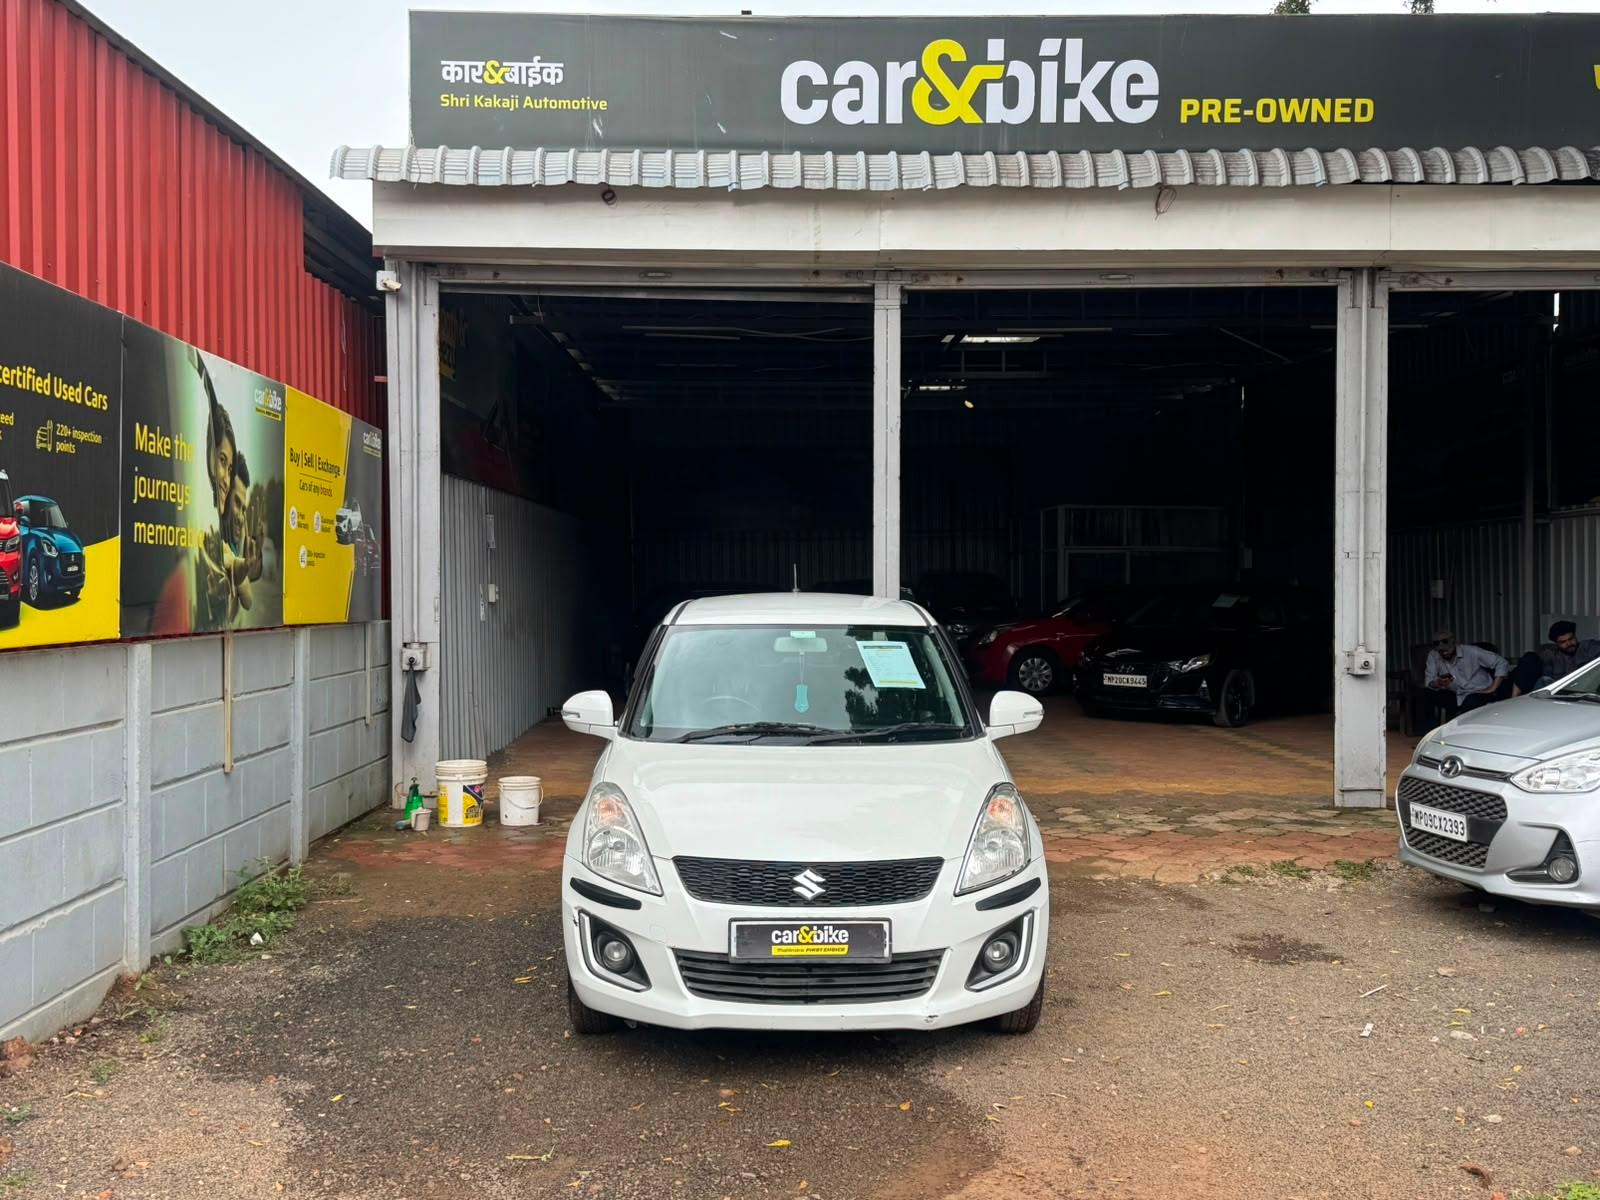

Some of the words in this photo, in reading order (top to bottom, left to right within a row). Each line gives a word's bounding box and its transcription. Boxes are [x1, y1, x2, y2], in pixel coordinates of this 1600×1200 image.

[780, 38, 1160, 126] car&bike
[440, 94, 470, 107] Shri
[474, 94, 519, 111] Kakaji
[523, 96, 608, 110] Automotive
[1180, 98, 1375, 124] PRE-OWNED
[54, 376, 82, 404] Used
[85, 386, 108, 411] Cars
[0, 412, 14, 426] eed
[56, 440, 76, 454] points
[72, 425, 102, 444] inspection
[135, 422, 171, 458] Make
[290, 447, 300, 467] Buy
[304, 452, 314, 468] Sell
[318, 456, 340, 478] Exchange
[133, 466, 192, 511] journeys
[1414, 809, 1465, 837] MP09CX2393
[771, 925, 849, 944] car&bike
